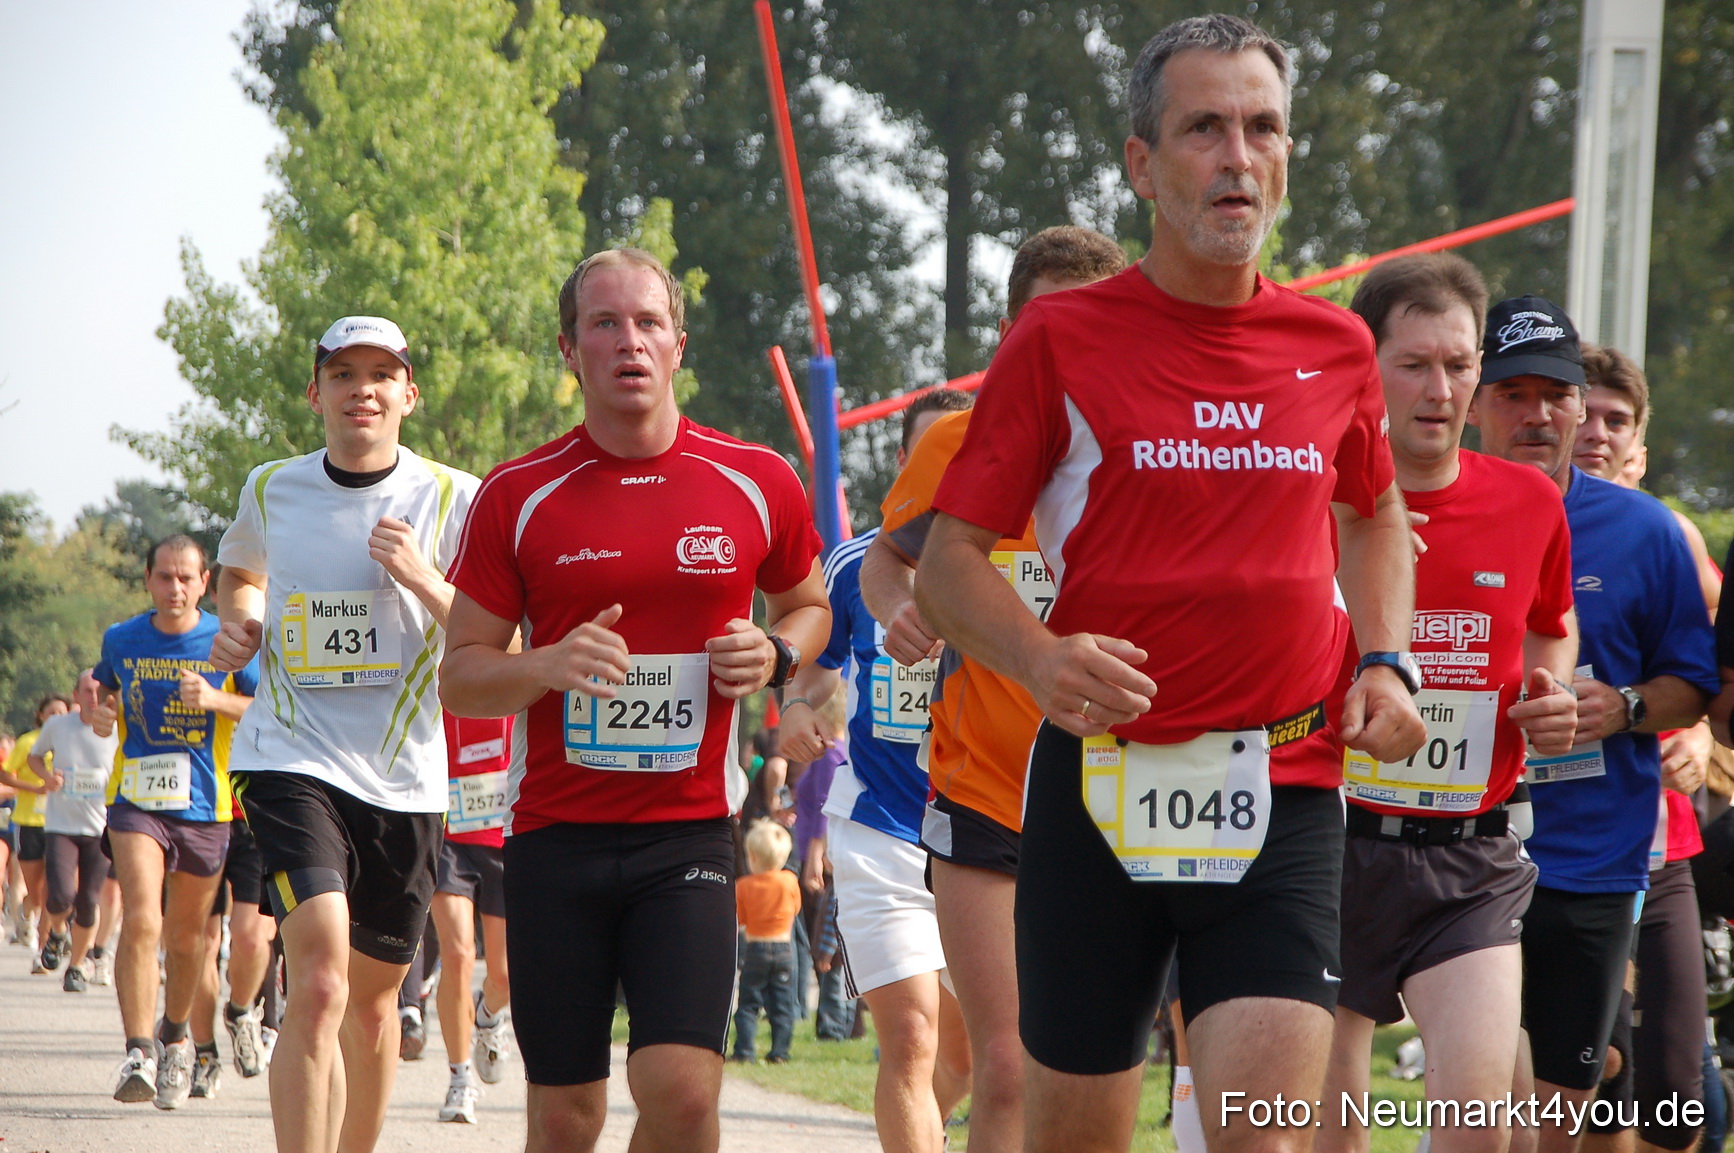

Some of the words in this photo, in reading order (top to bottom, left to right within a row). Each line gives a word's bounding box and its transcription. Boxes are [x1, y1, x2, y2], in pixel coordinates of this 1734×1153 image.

[1498, 319, 1565, 352] Champ
[1193, 401, 1264, 430] DAV
[1132, 438, 1324, 475] Röthenbach
[621, 475, 657, 485] CRAFT
[684, 524, 723, 534] Laufteam
[677, 565, 710, 574] Kraftsport
[312, 599, 368, 618] Markus
[286, 629, 294, 643] C
[324, 627, 378, 655] 431
[897, 666, 937, 682] Christ
[1424, 667, 1436, 675] für
[1437, 666, 1480, 677] Feuerwehr,
[1429, 676, 1448, 684] THW
[1449, 677, 1464, 685] und
[1464, 676, 1488, 686] Polizei
[876, 687, 882, 698] B
[574, 696, 582, 711] A
[899, 691, 928, 713] 24
[607, 699, 693, 729] 2245
[145, 775, 179, 791] 746
[466, 793, 505, 811] 2572
[1139, 788, 1256, 831] 1048
[701, 870, 727, 885] asics
